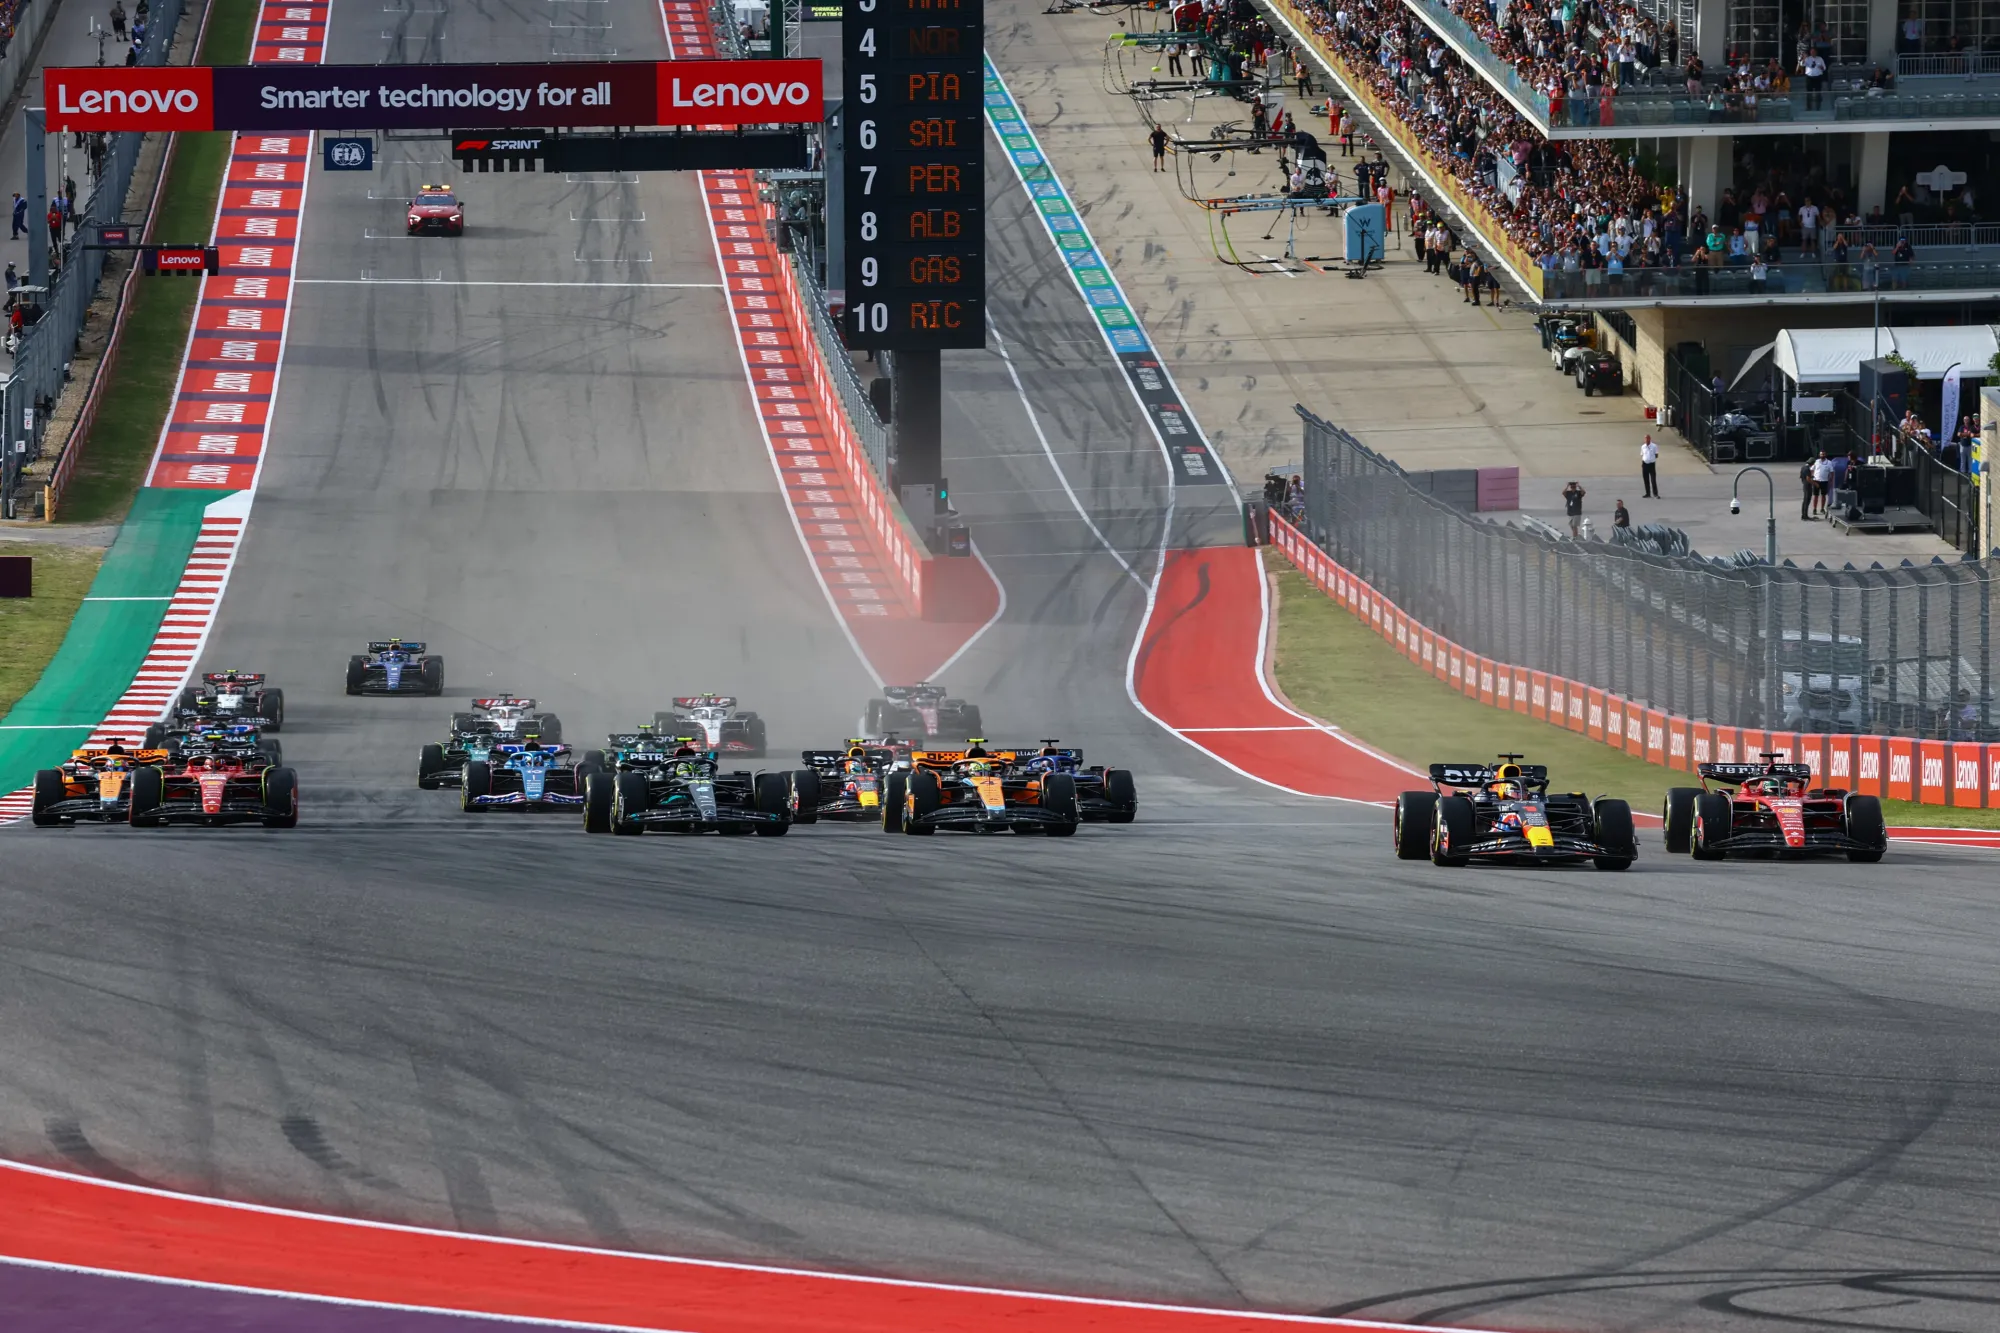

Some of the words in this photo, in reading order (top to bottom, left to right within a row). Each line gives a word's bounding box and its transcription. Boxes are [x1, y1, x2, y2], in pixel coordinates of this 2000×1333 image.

[860, 29, 876, 57] 4
[59, 85, 199, 114] Lenovo
[261, 86, 369, 109] Smarter
[379, 84, 531, 111] technology
[538, 82, 576, 106] for
[582, 82, 610, 106] all
[673, 78, 809, 107] Lenovo
[860, 75, 876, 103] 5
[910, 74, 959, 101] PIA
[491, 140, 541, 150] SPRINT
[860, 120, 876, 149] 6
[910, 120, 956, 146] SAI
[861, 166, 876, 195] 7
[910, 166, 959, 192] PER
[861, 212, 877, 241] 8
[911, 212, 959, 237] ALB
[161, 255, 200, 264] Lenovo
[862, 258, 877, 287] 9
[911, 258, 959, 283] GAS
[853, 303, 887, 332] 10
[911, 303, 960, 328] RIC
[1831, 744, 1850, 777] Lenovo
[1860, 745, 1879, 779] Lenovo
[1890, 748, 1911, 782] Lenovo
[1922, 751, 1943, 787] Lenovo
[1954, 753, 1979, 790] Lenovo
